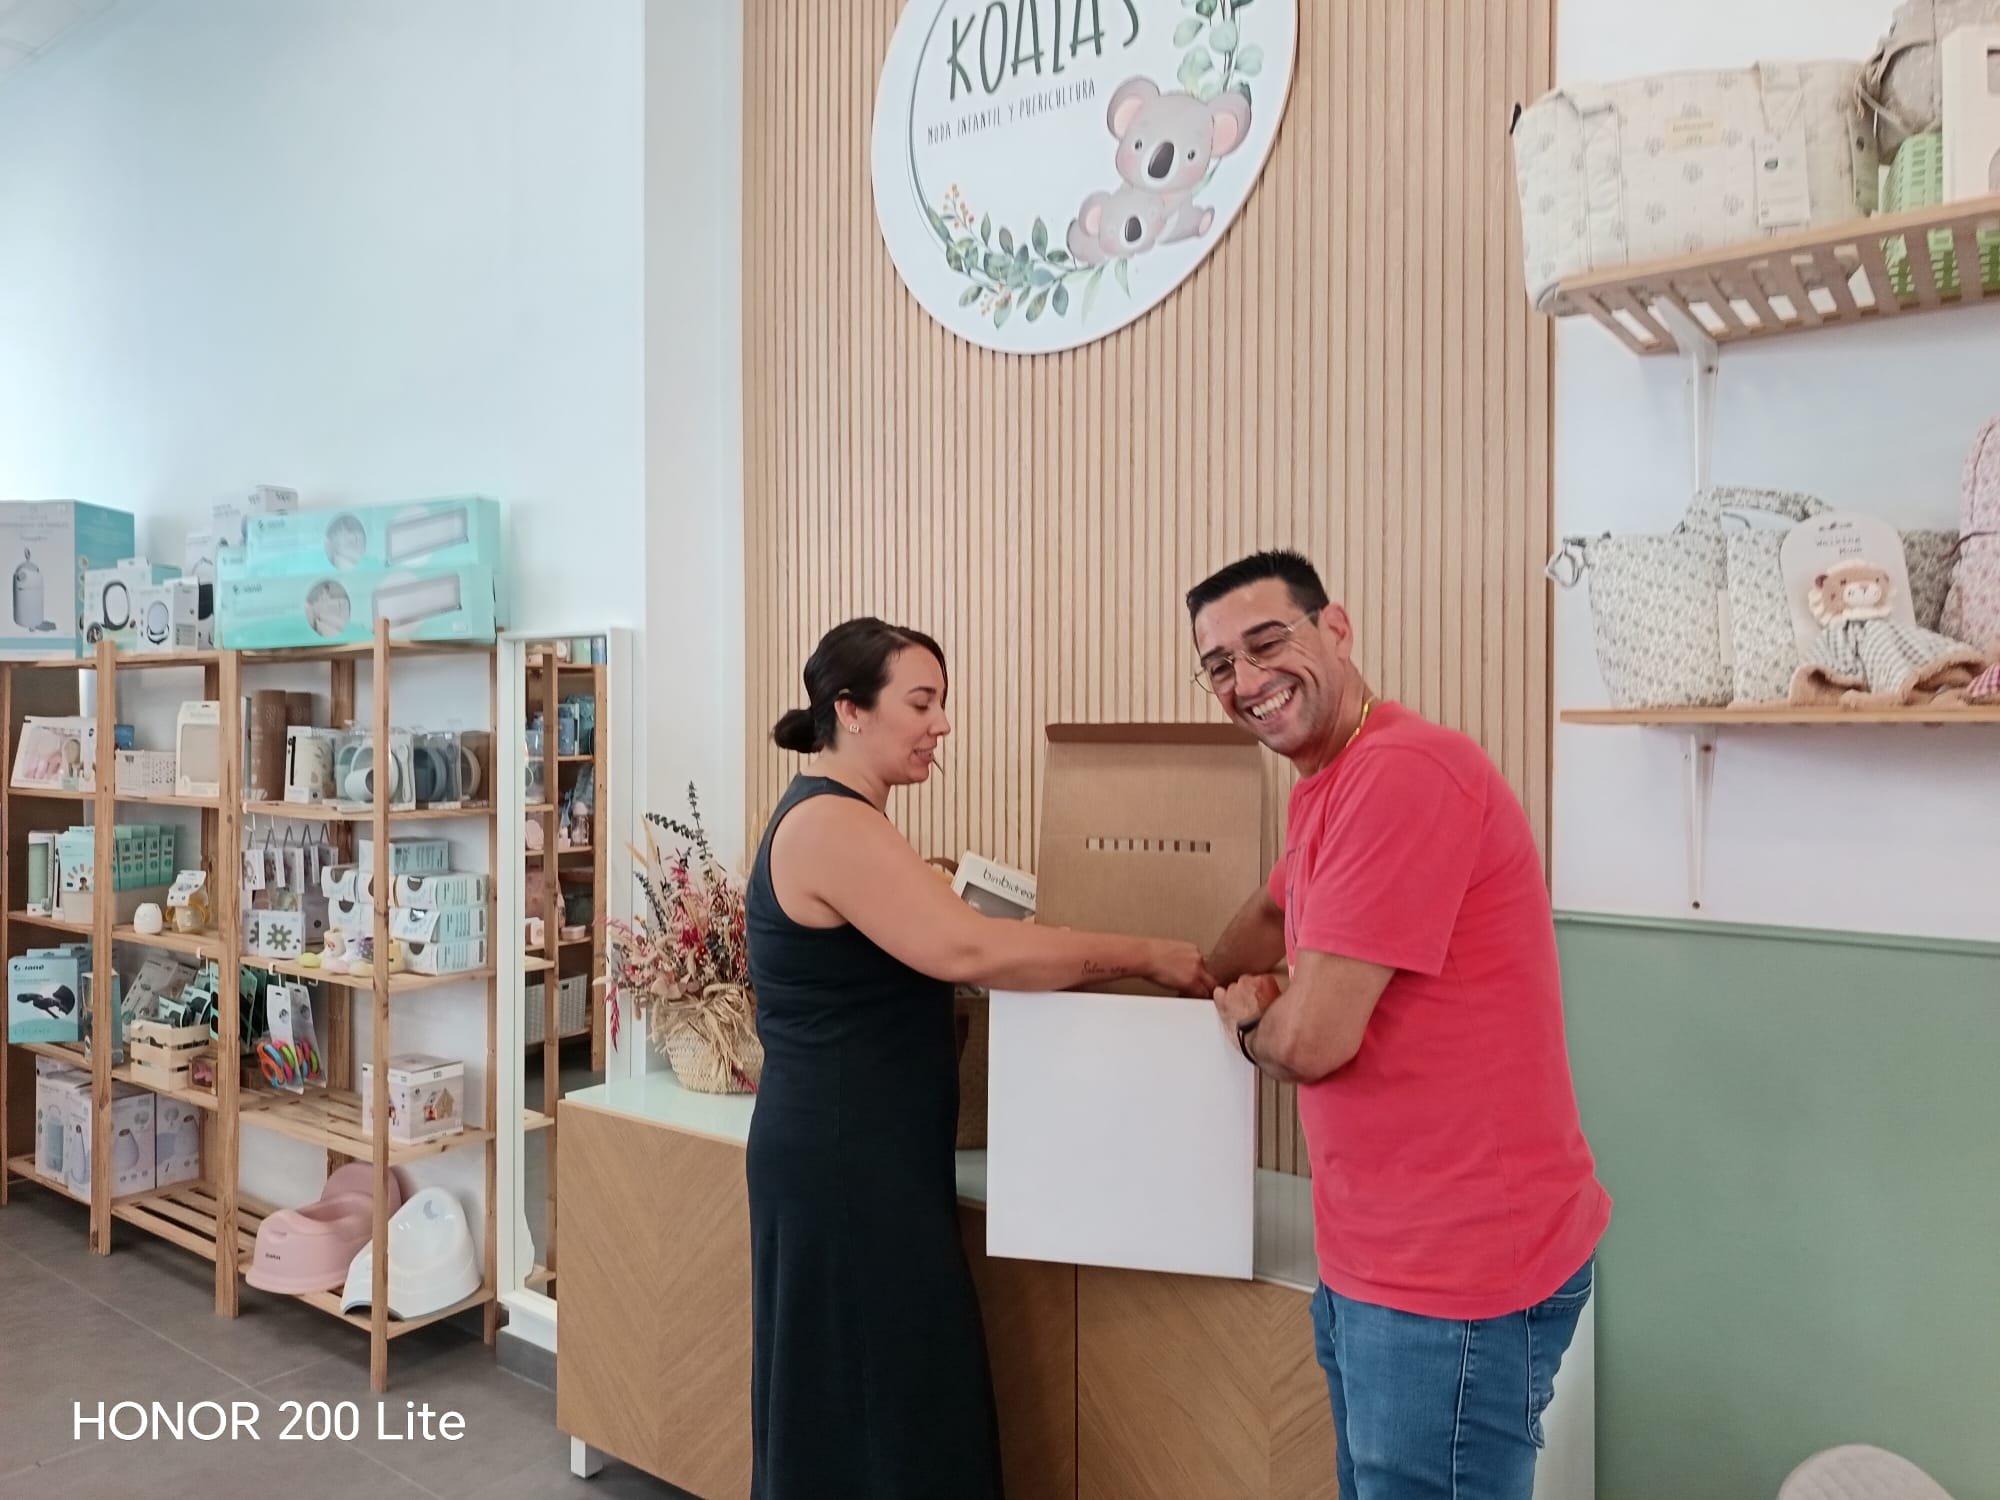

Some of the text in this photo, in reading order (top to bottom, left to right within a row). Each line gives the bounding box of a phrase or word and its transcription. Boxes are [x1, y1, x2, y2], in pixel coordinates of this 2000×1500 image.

[927, 77, 1096, 145] MODA INFANTIL Y PUERICULTURA
